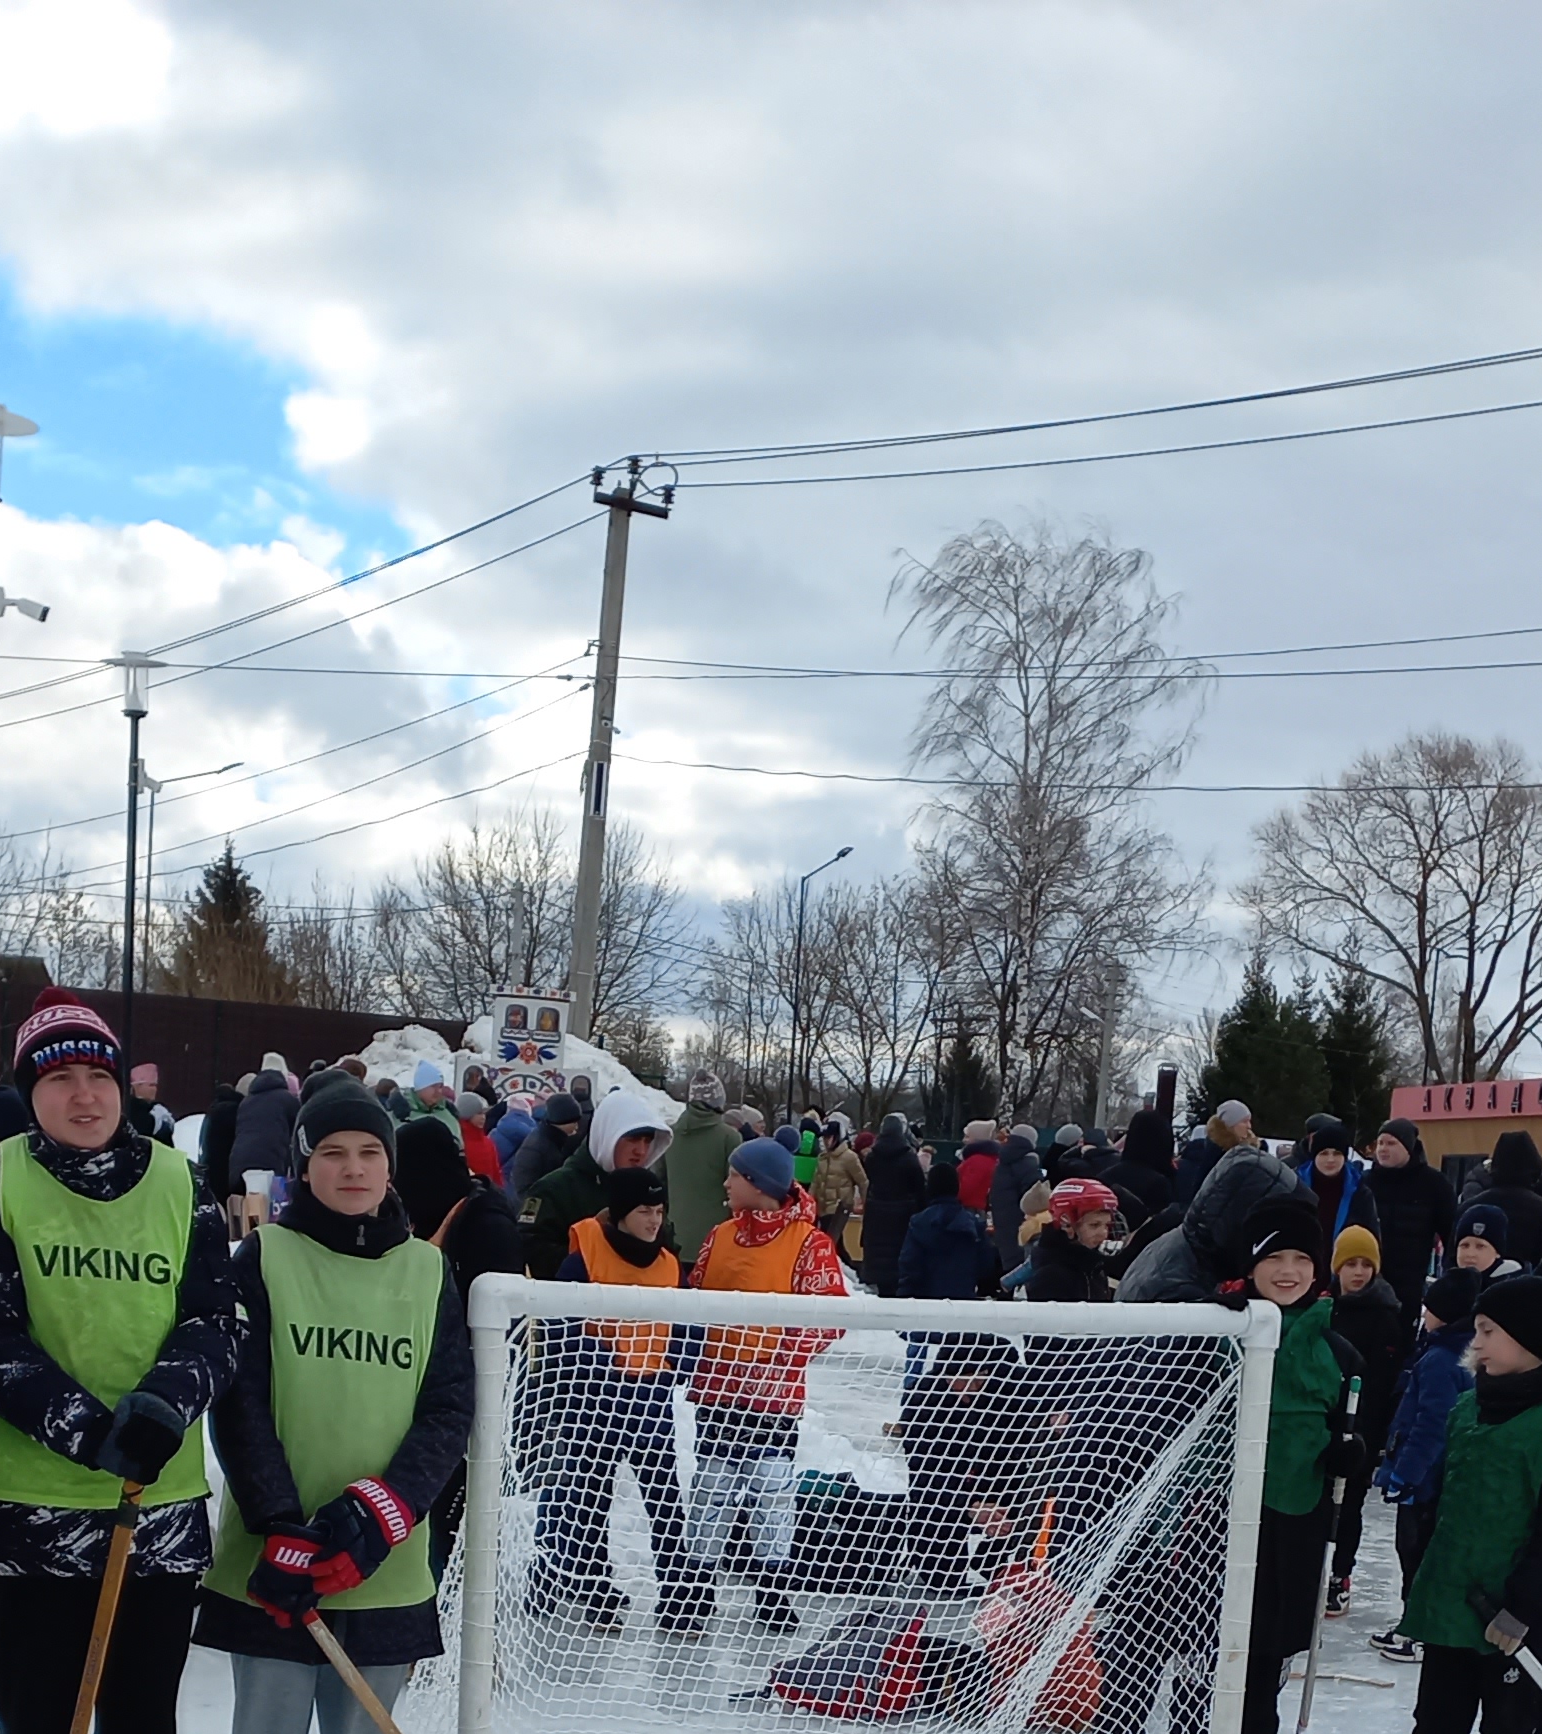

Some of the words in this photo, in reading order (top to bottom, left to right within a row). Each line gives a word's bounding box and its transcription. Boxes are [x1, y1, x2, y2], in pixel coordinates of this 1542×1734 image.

[31, 1040, 116, 1075] RUSSIA
[32, 1244, 171, 1285] VIKING
[289, 1323, 413, 1370] VIKING
